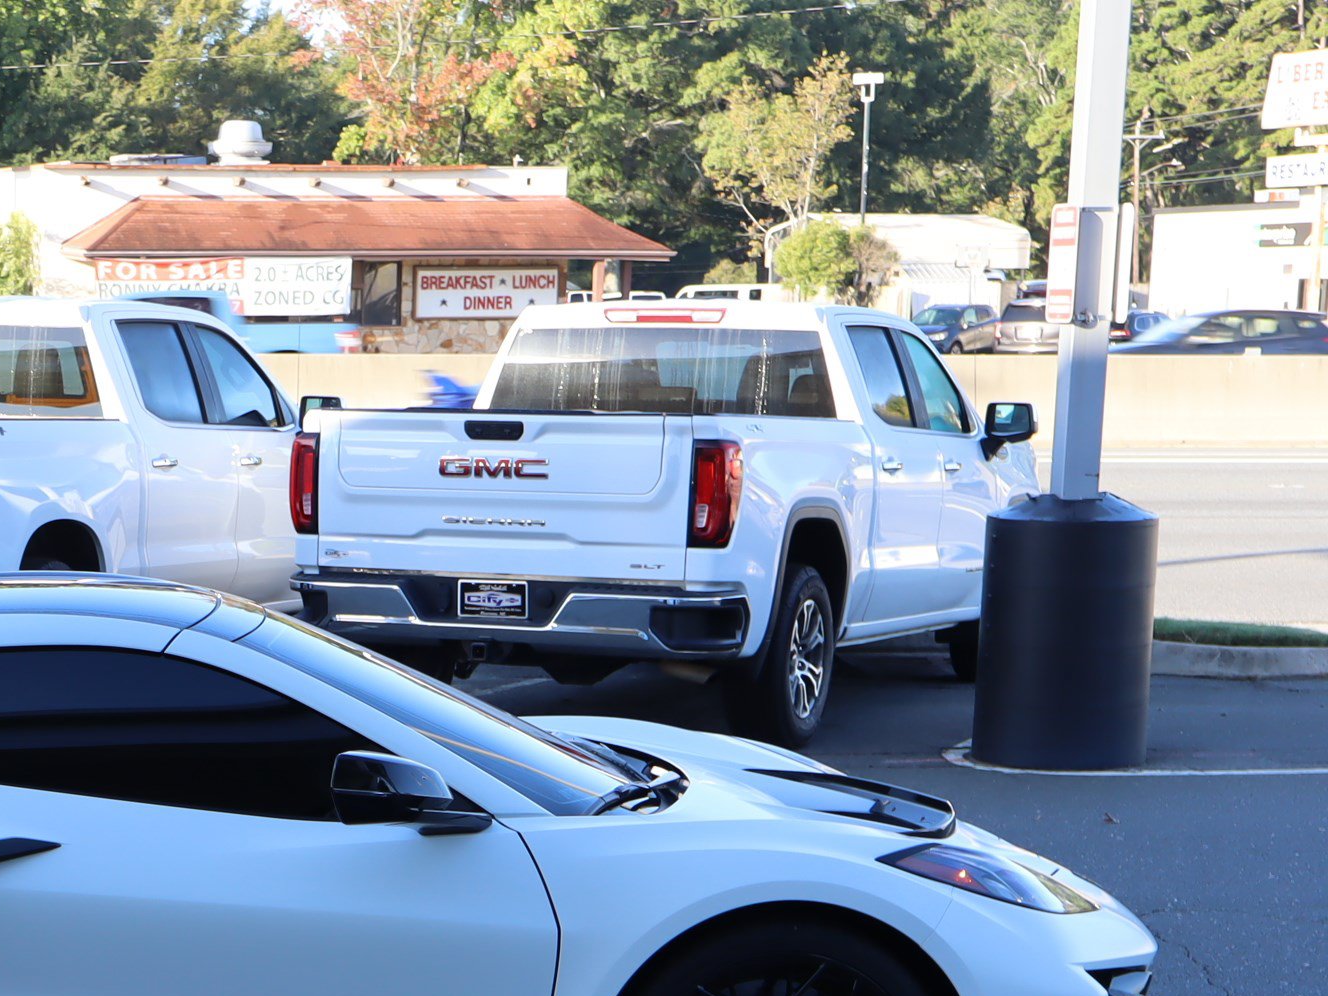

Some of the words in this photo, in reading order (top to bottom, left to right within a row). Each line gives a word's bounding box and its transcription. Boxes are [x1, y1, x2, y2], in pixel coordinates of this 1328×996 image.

[97, 261, 158, 280] FOR
[169, 259, 242, 280] SALE
[254, 266, 276, 282] 2.0
[296, 264, 344, 282] ACRES
[421, 275, 495, 290] BREAKFAST
[513, 275, 555, 289] LUNCH
[254, 290, 315, 306] ZONED
[463, 295, 512, 310] DINNER
[438, 456, 549, 479] GMC
[441, 515, 546, 527] SIERRA
